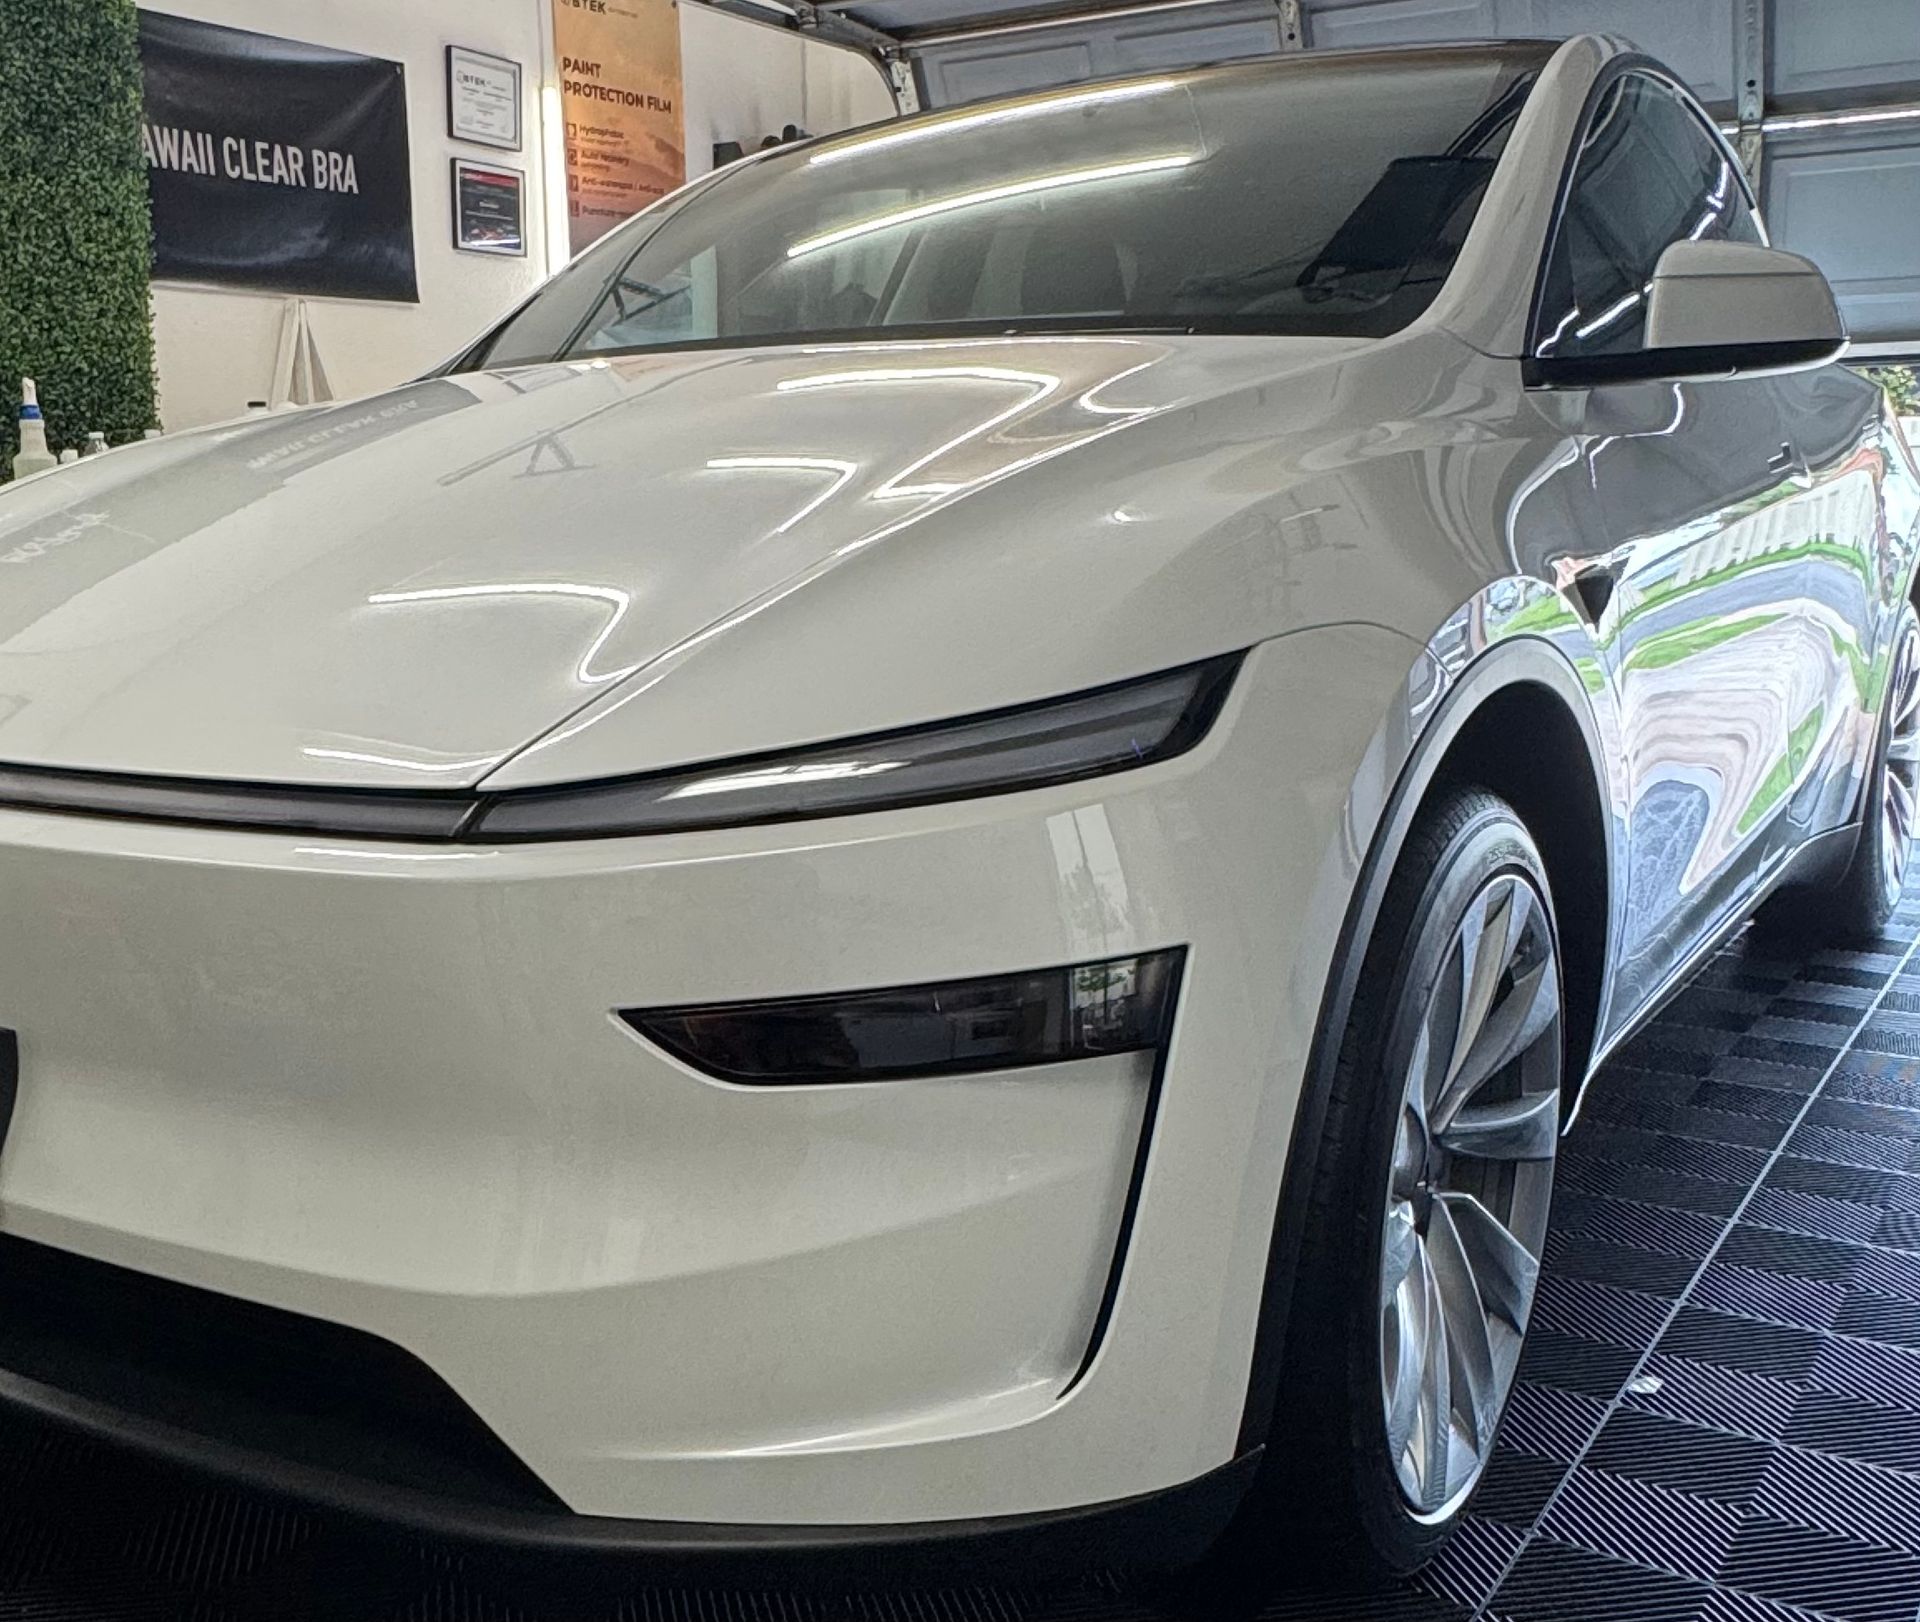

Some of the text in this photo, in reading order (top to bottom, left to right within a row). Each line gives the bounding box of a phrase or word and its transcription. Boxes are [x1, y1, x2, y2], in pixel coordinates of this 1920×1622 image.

[562, 56, 601, 78] PAINT
[563, 80, 672, 114] PROTECTION FILM
[141, 123, 359, 195] AWAII CLEAR BRA
